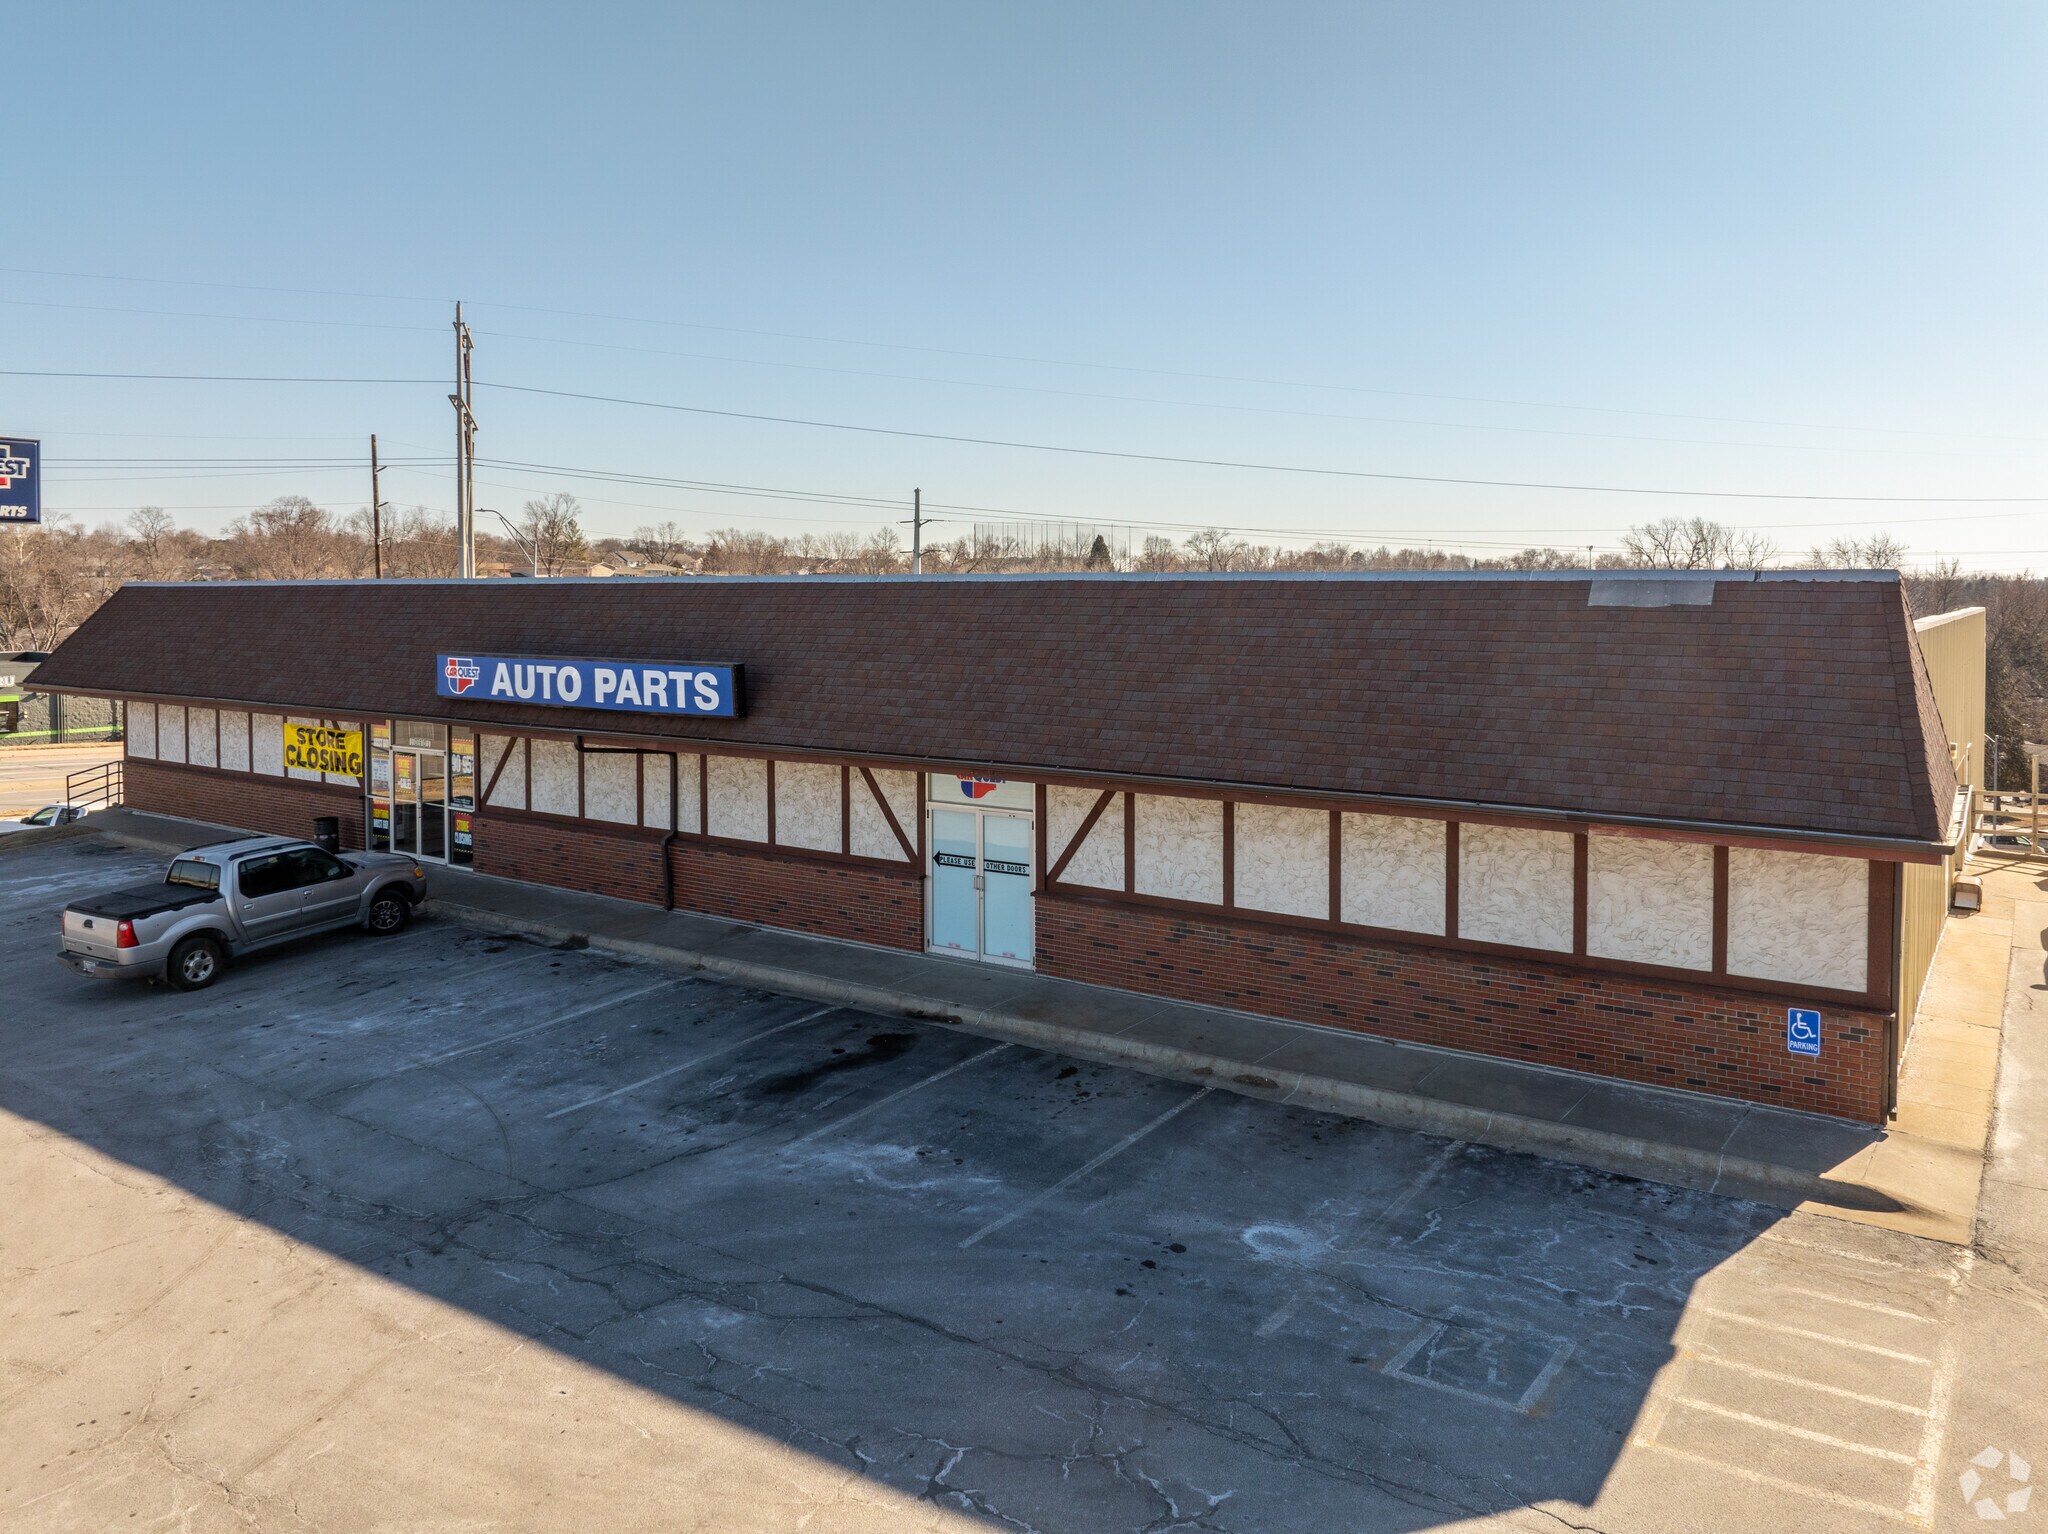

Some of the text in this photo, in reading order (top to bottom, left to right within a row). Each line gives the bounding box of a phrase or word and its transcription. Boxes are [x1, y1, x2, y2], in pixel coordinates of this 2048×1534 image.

[491, 662, 720, 711] AUTO PARTS
[296, 727, 347, 750] STORE
[286, 744, 361, 775] CLOSING
[940, 856, 1026, 873] PLEASE USE OTHER DOORS
[1790, 1040, 1818, 1051] PARKING
